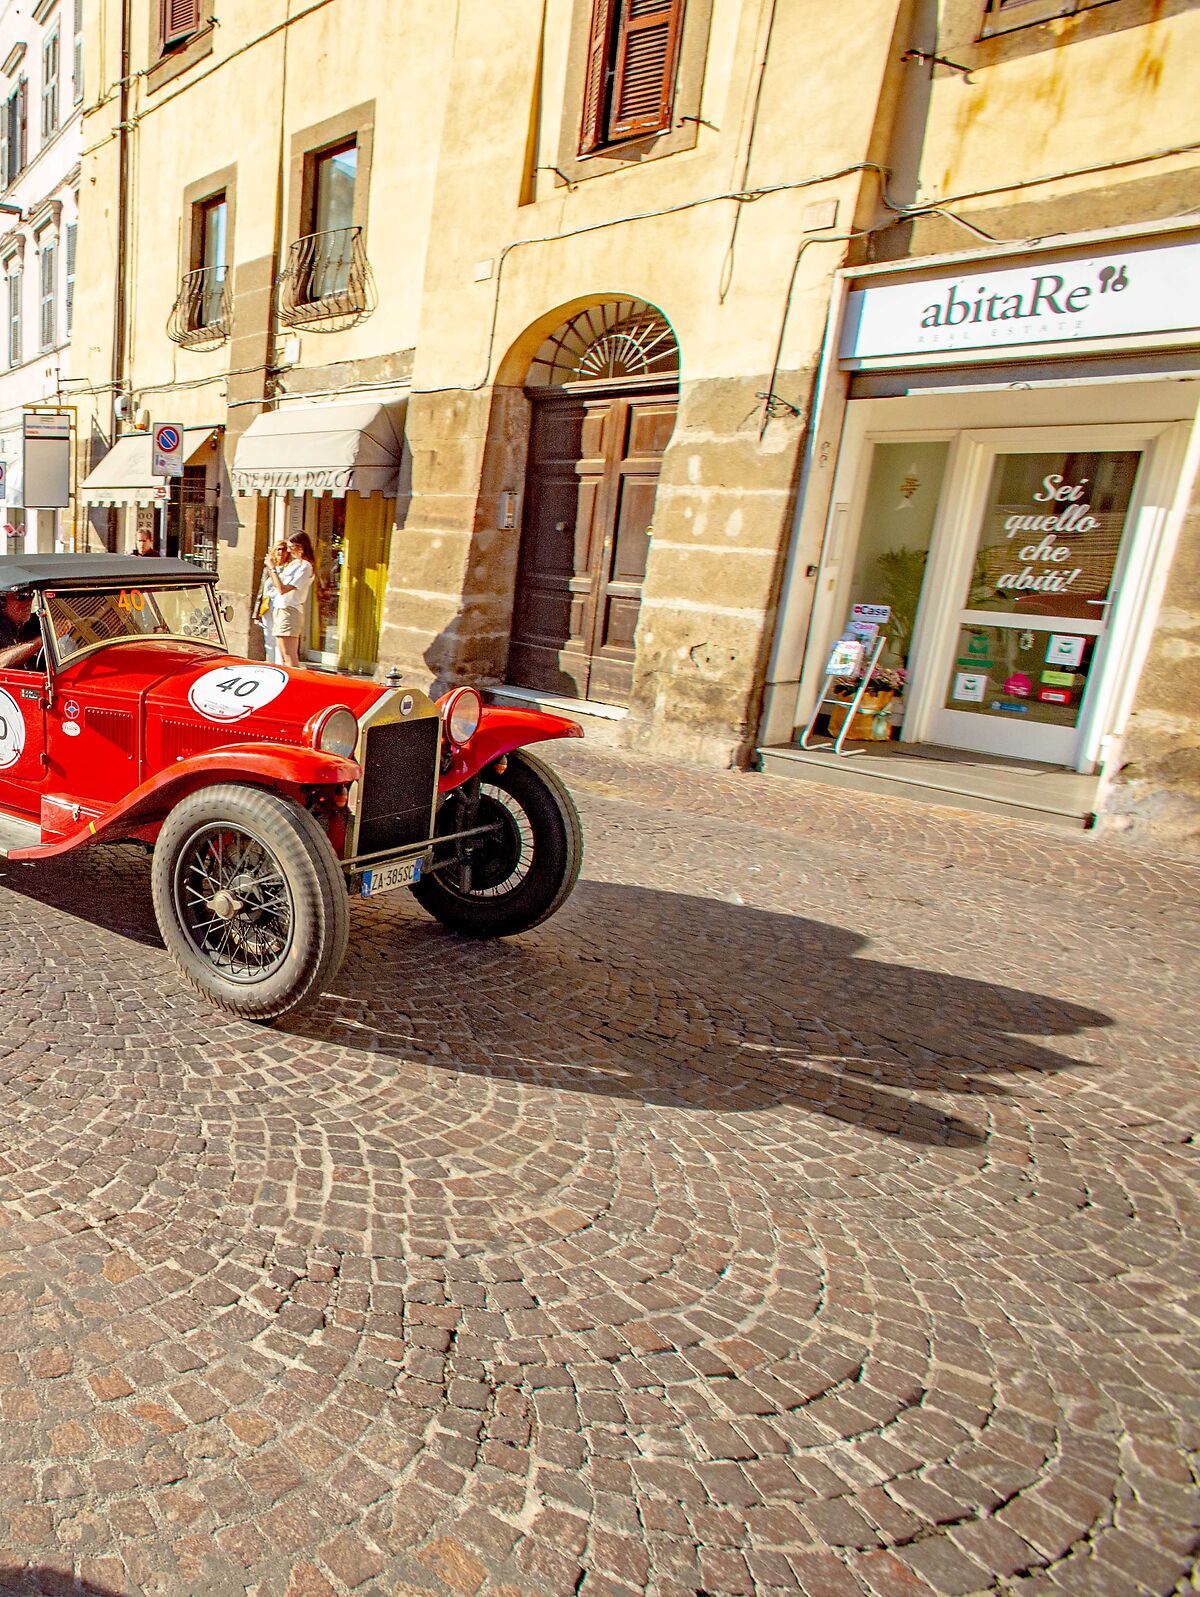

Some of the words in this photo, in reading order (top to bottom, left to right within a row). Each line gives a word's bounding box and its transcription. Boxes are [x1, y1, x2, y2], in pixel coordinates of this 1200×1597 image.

[921, 275, 1091, 328] abitaRe
[262, 471, 300, 488] PIZZA
[304, 470, 354, 488] DOLCI
[1033, 474, 1089, 502] Sei
[1003, 503, 1101, 538] quello
[1018, 534, 1072, 562] che
[995, 566, 1082, 592] abiti!
[118, 589, 145, 612] 40
[216, 676, 260, 697] 40
[372, 873, 383, 890] ZA
